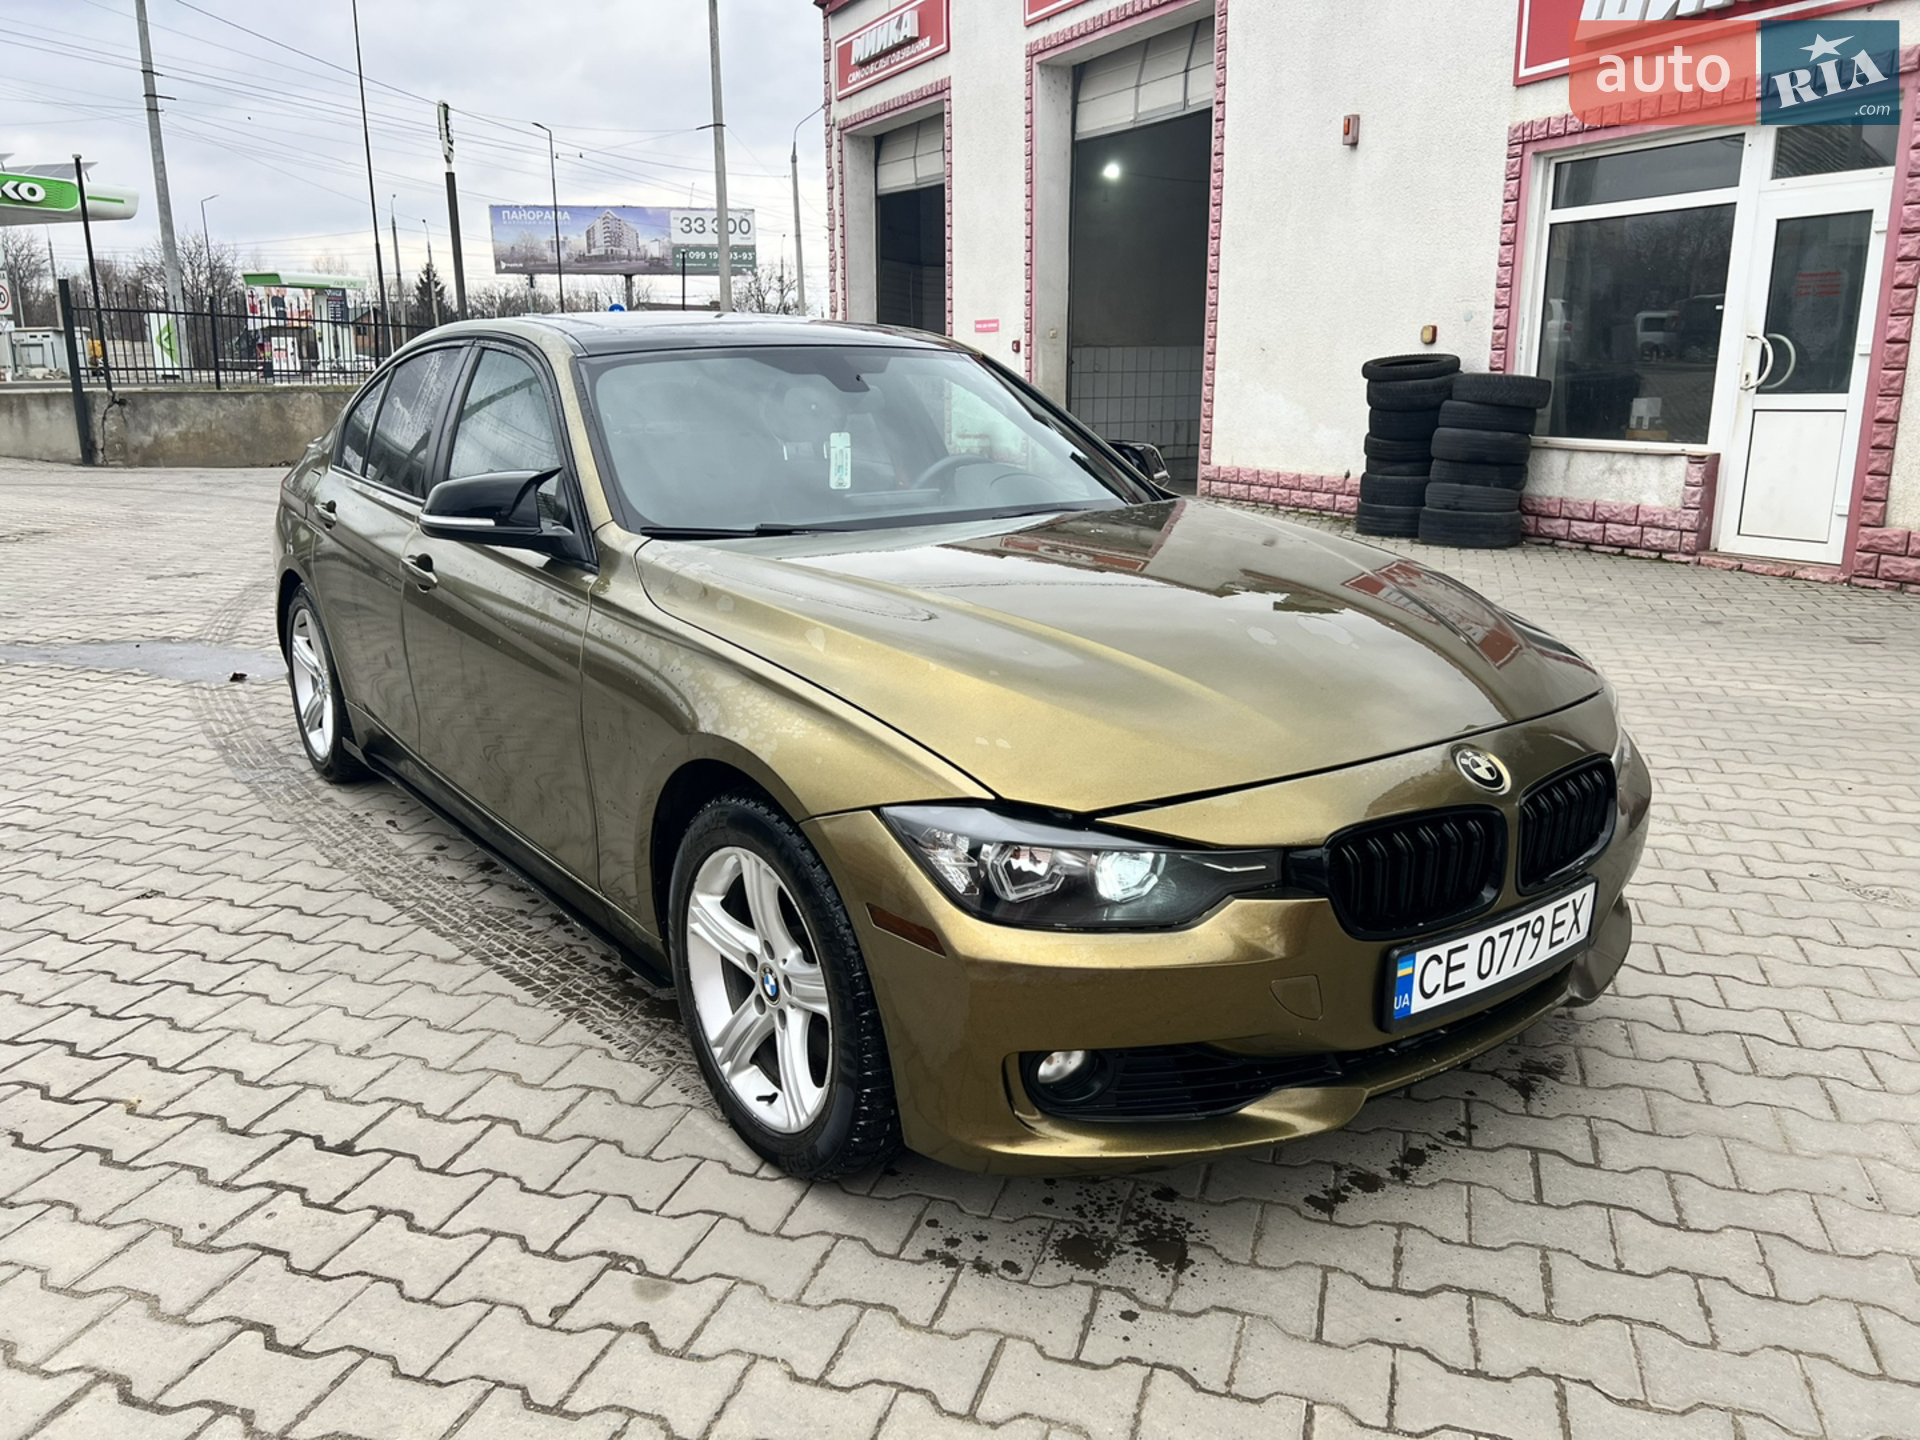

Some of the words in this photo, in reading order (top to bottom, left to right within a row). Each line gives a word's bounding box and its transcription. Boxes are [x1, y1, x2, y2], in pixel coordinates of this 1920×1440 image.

[0, 180, 46, 203] KO
[501, 209, 571, 221] ПАНОРАМА
[680, 216, 706, 234] 33
[1418, 942, 1469, 1000] CE
[1476, 914, 1545, 981] 0779
[1548, 891, 1587, 950] EX
[1394, 993, 1410, 1010] UA
